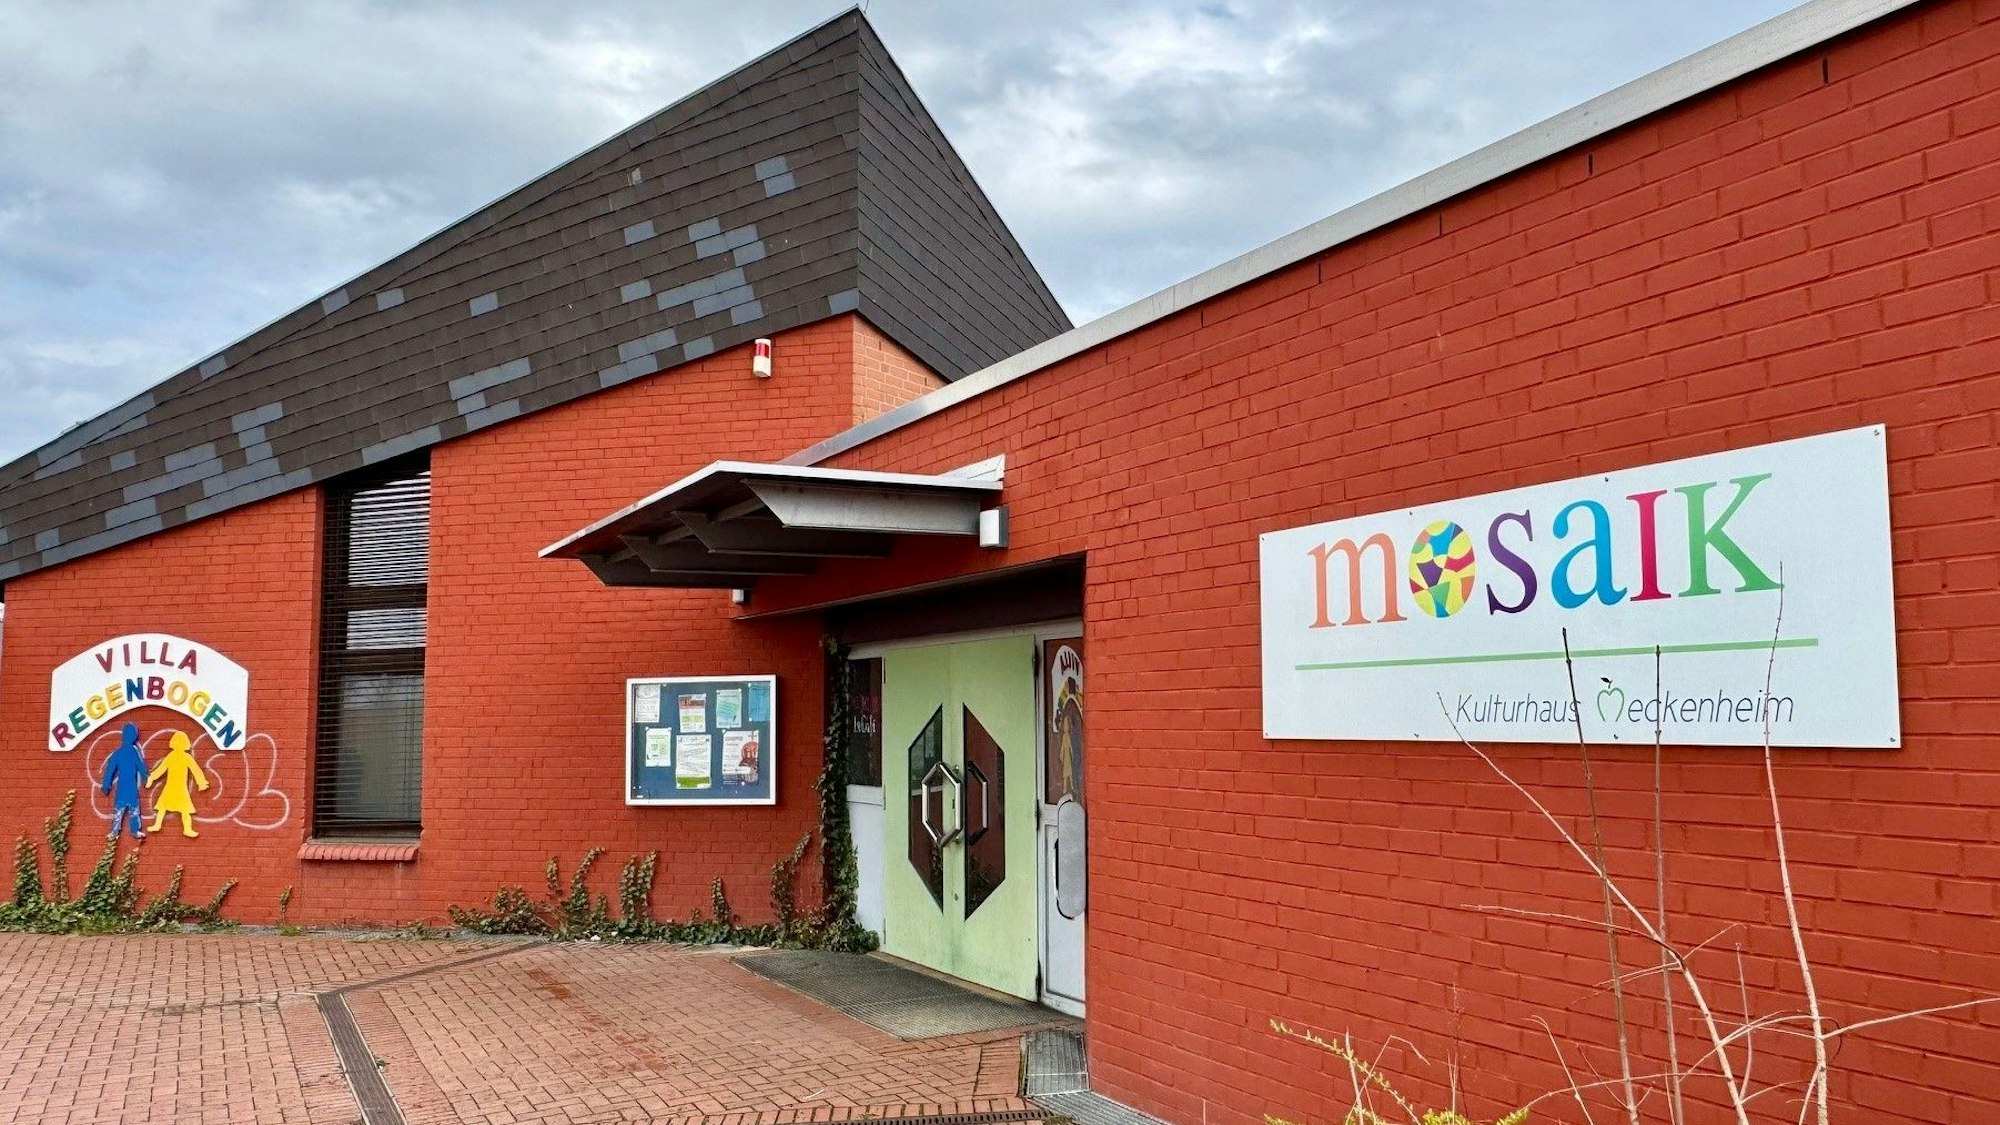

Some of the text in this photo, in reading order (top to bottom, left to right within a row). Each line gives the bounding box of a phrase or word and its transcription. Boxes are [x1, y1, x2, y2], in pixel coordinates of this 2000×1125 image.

[95, 641, 197, 675] VILLA
[51, 676, 242, 748] REGENBOGEN
[1456, 693, 1581, 723] Kulturhaus
